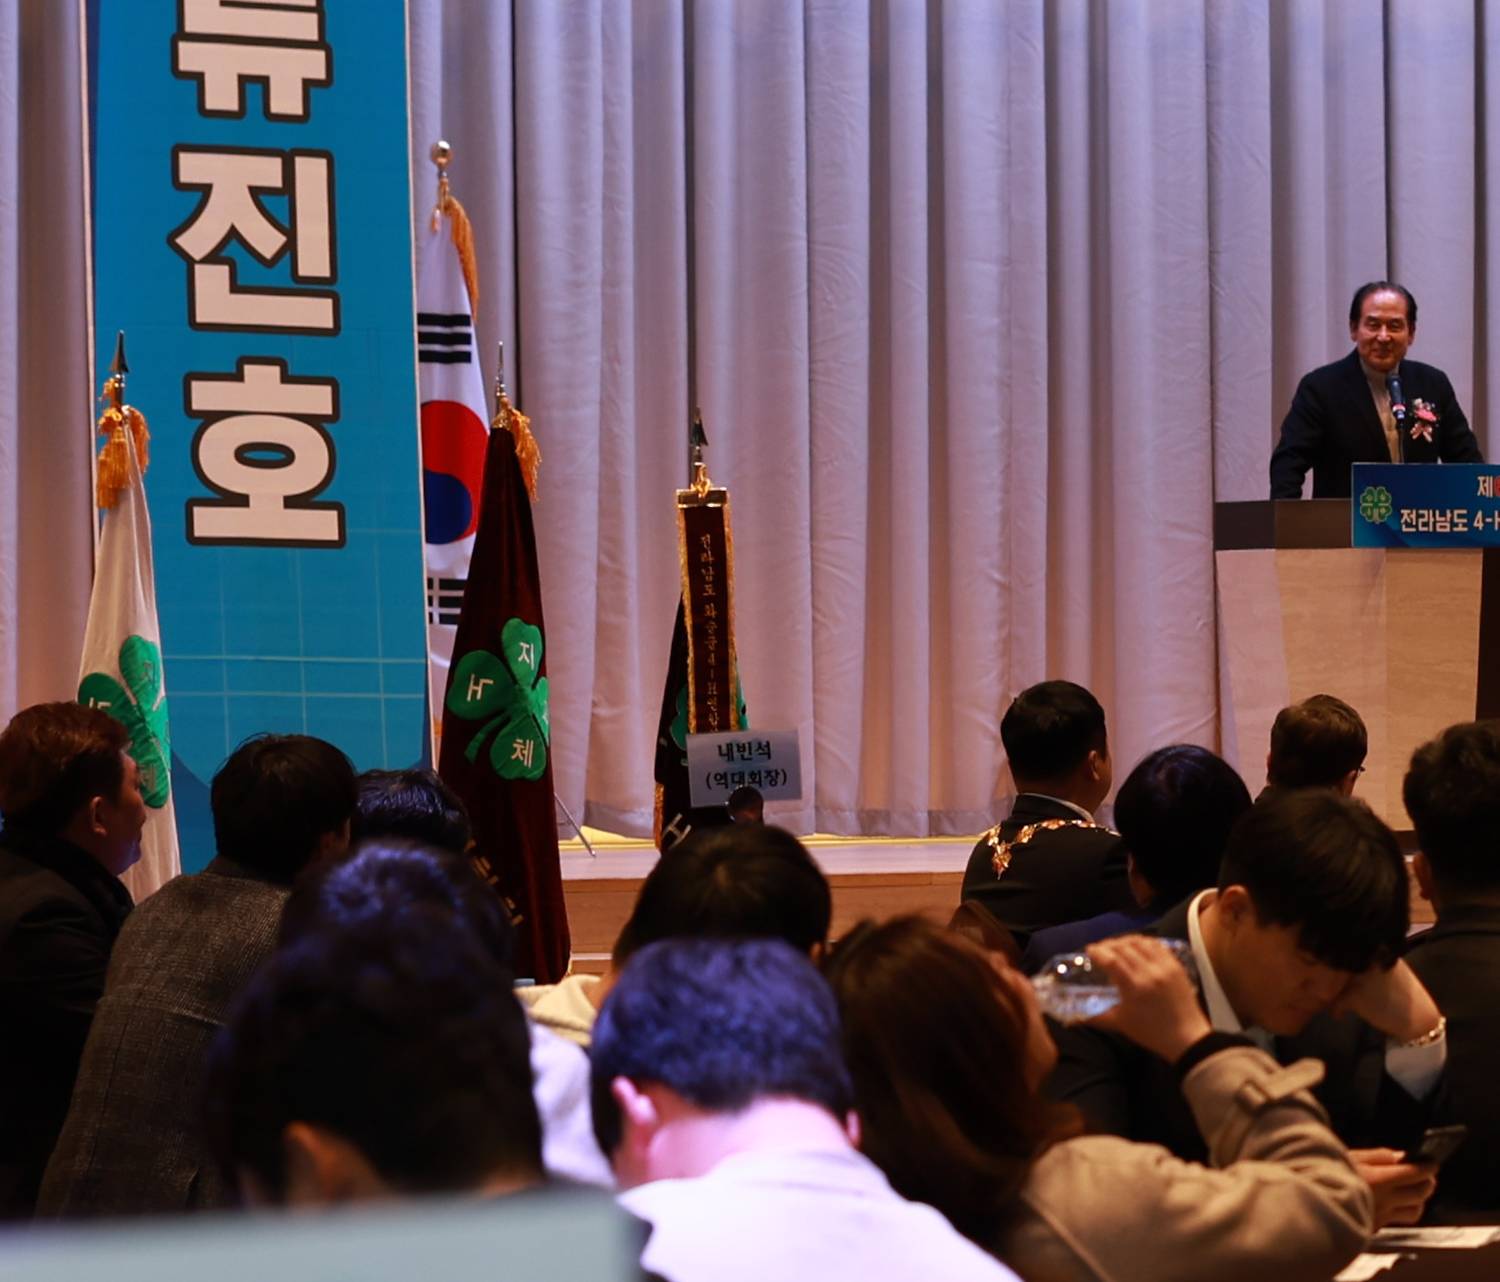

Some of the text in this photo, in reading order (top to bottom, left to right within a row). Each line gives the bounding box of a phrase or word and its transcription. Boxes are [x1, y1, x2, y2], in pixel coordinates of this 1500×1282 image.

[1400, 509, 1468, 533] 전라남도
[518, 641, 534, 670] 지
[466, 674, 494, 702] 노
[717, 740, 772, 763] 내빈석
[706, 768, 787, 791] (역대회장)
